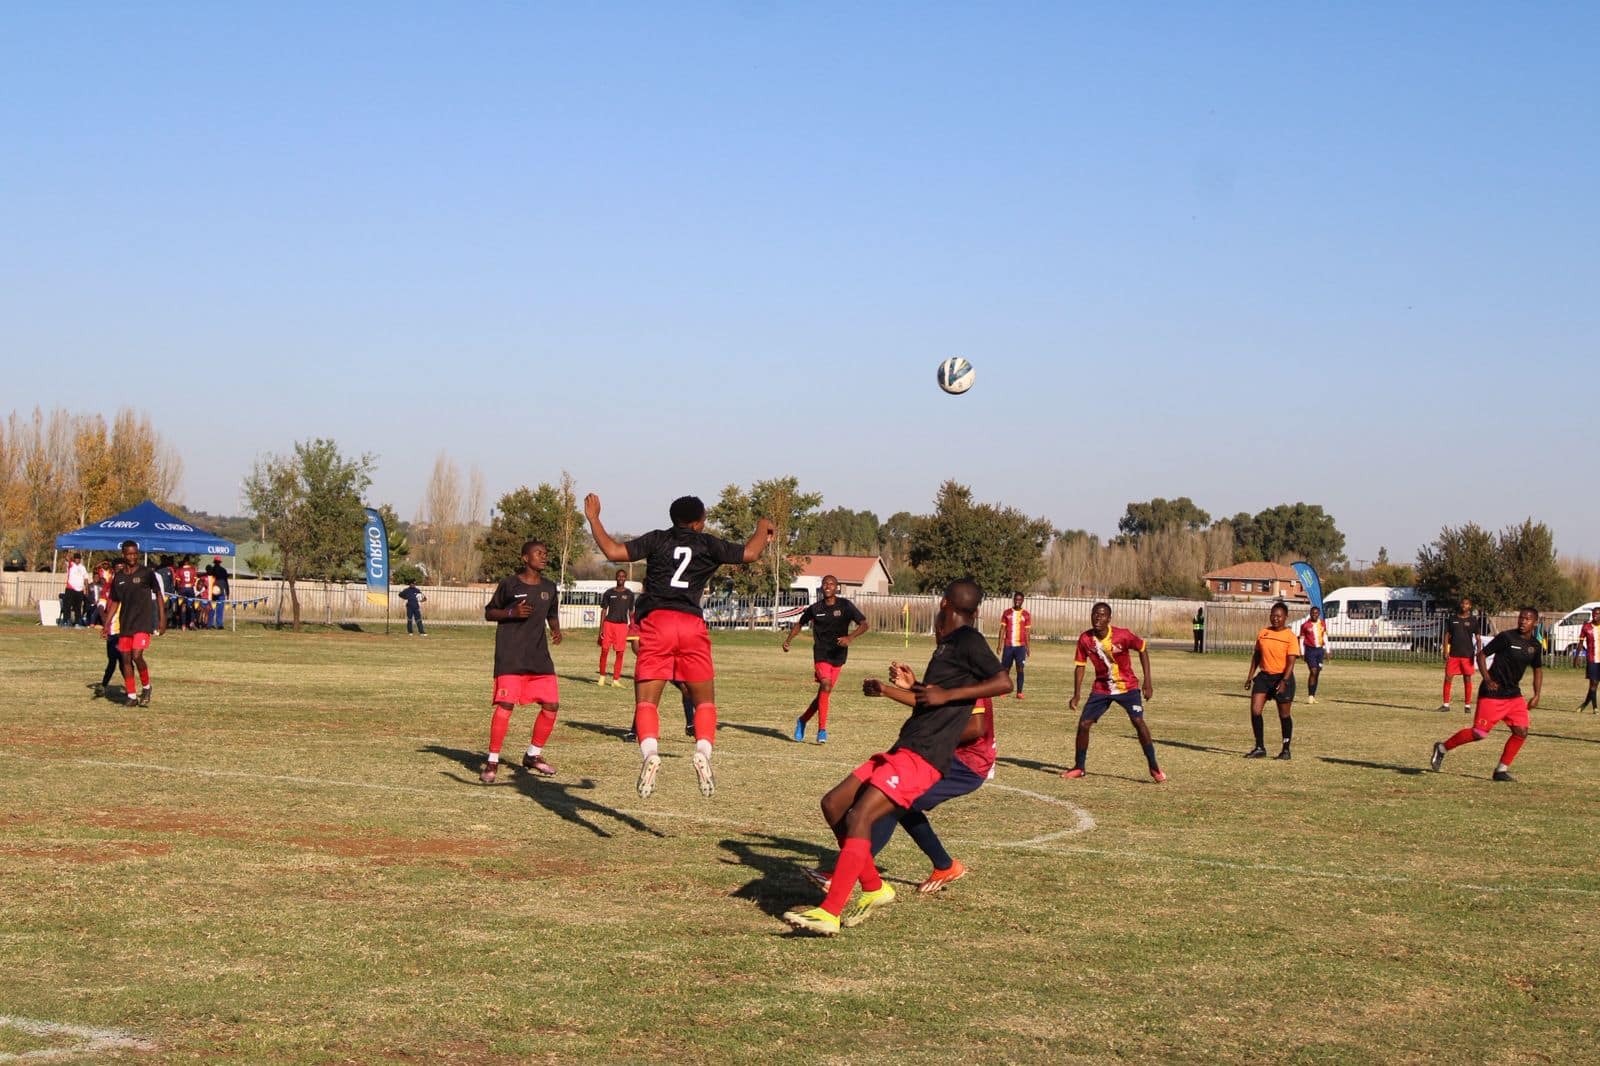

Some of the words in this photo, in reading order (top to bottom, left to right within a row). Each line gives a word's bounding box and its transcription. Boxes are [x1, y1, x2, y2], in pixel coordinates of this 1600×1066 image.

[100, 521, 140, 529] CURRO
[154, 522, 194, 532] CURRO
[207, 545, 230, 554] CURRO
[670, 546, 692, 588] 2
[183, 570, 191, 582] 9
